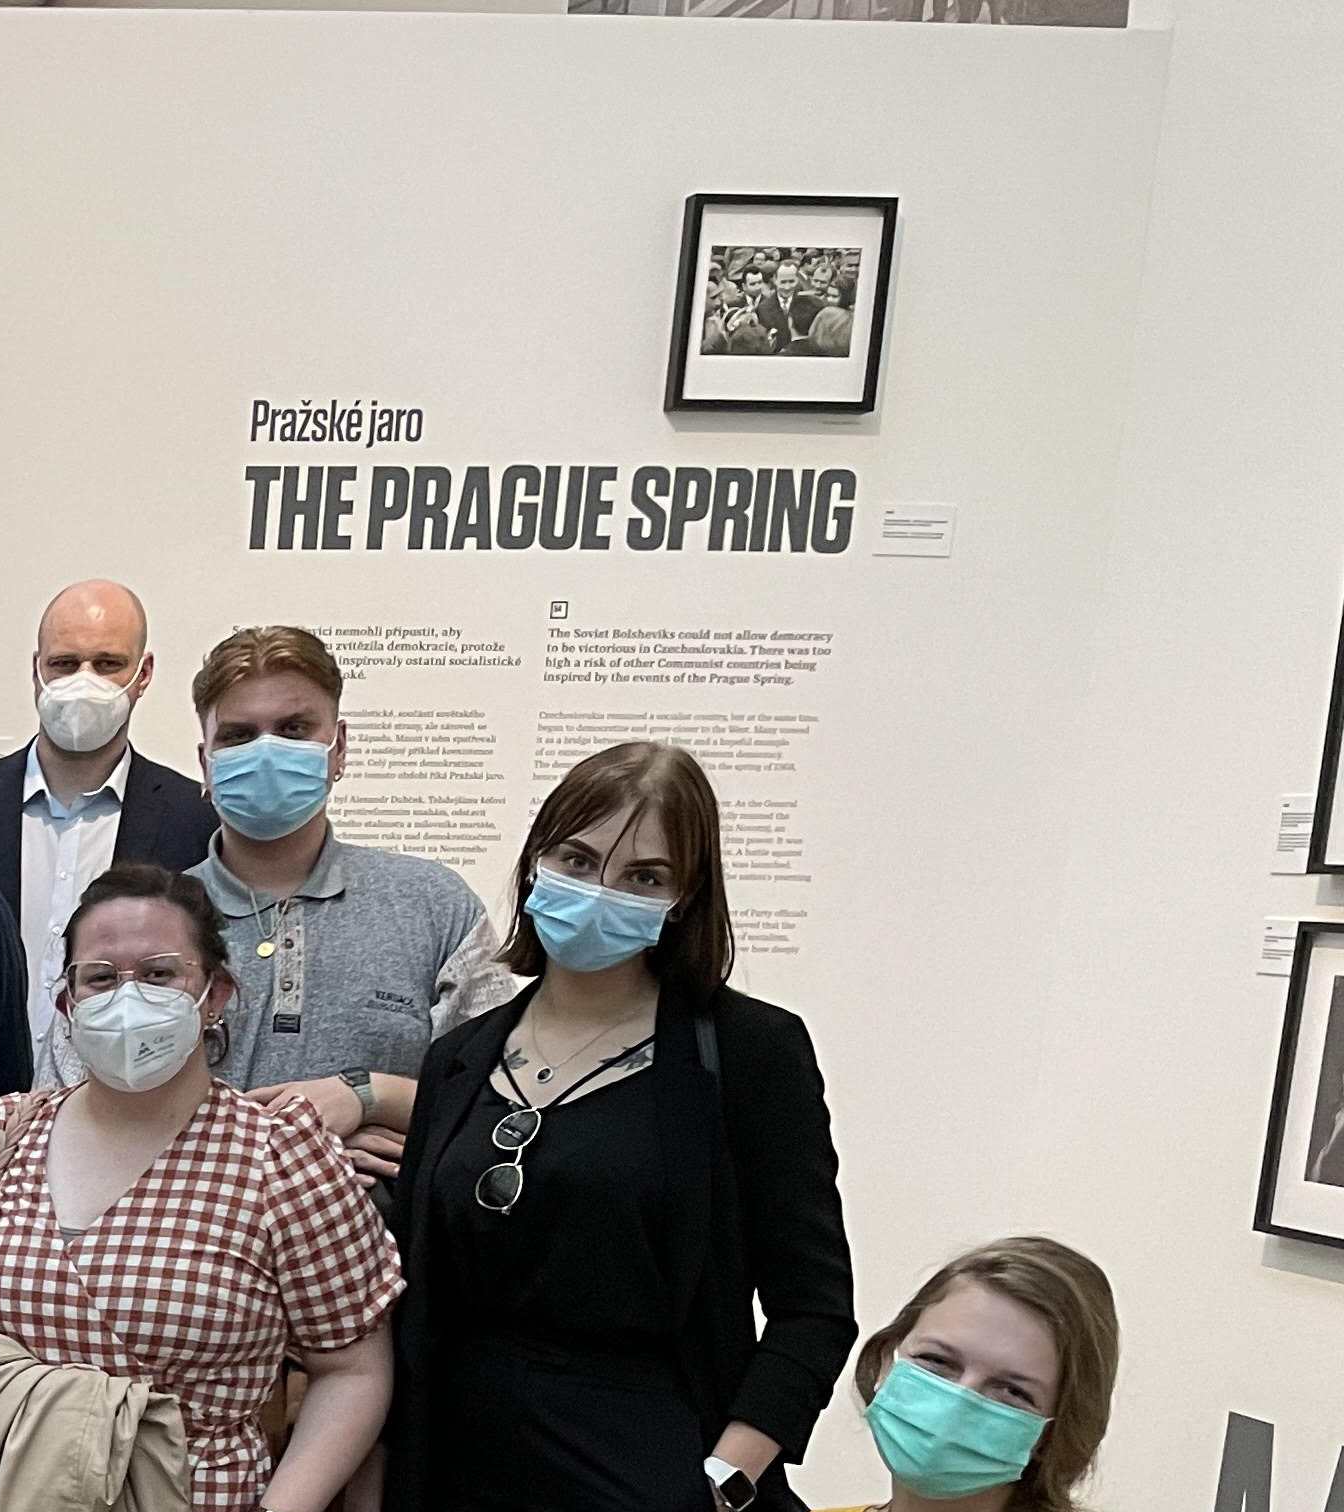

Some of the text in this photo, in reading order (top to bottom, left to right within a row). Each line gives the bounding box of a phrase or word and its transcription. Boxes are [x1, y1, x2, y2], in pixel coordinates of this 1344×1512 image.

[251, 399, 423, 449] Pražské jaro
[245, 465, 857, 554] THE PRAGUE SPRING
[335, 626, 462, 639] nemohli připustit, aby
[548, 628, 833, 642] The Soviet Bolsheviks could not allow democracy
[336, 641, 505, 653] zvítězila demokracie, protože
[547, 643, 831, 655] to be victorious in Czechoslovakia. There was too
[339, 655, 521, 667] inspirovaly ostatní socialistické
[546, 657, 816, 671] high a risk of other Communist countries being
[544, 671, 793, 685] inspired by the events of the Prague Spring.
